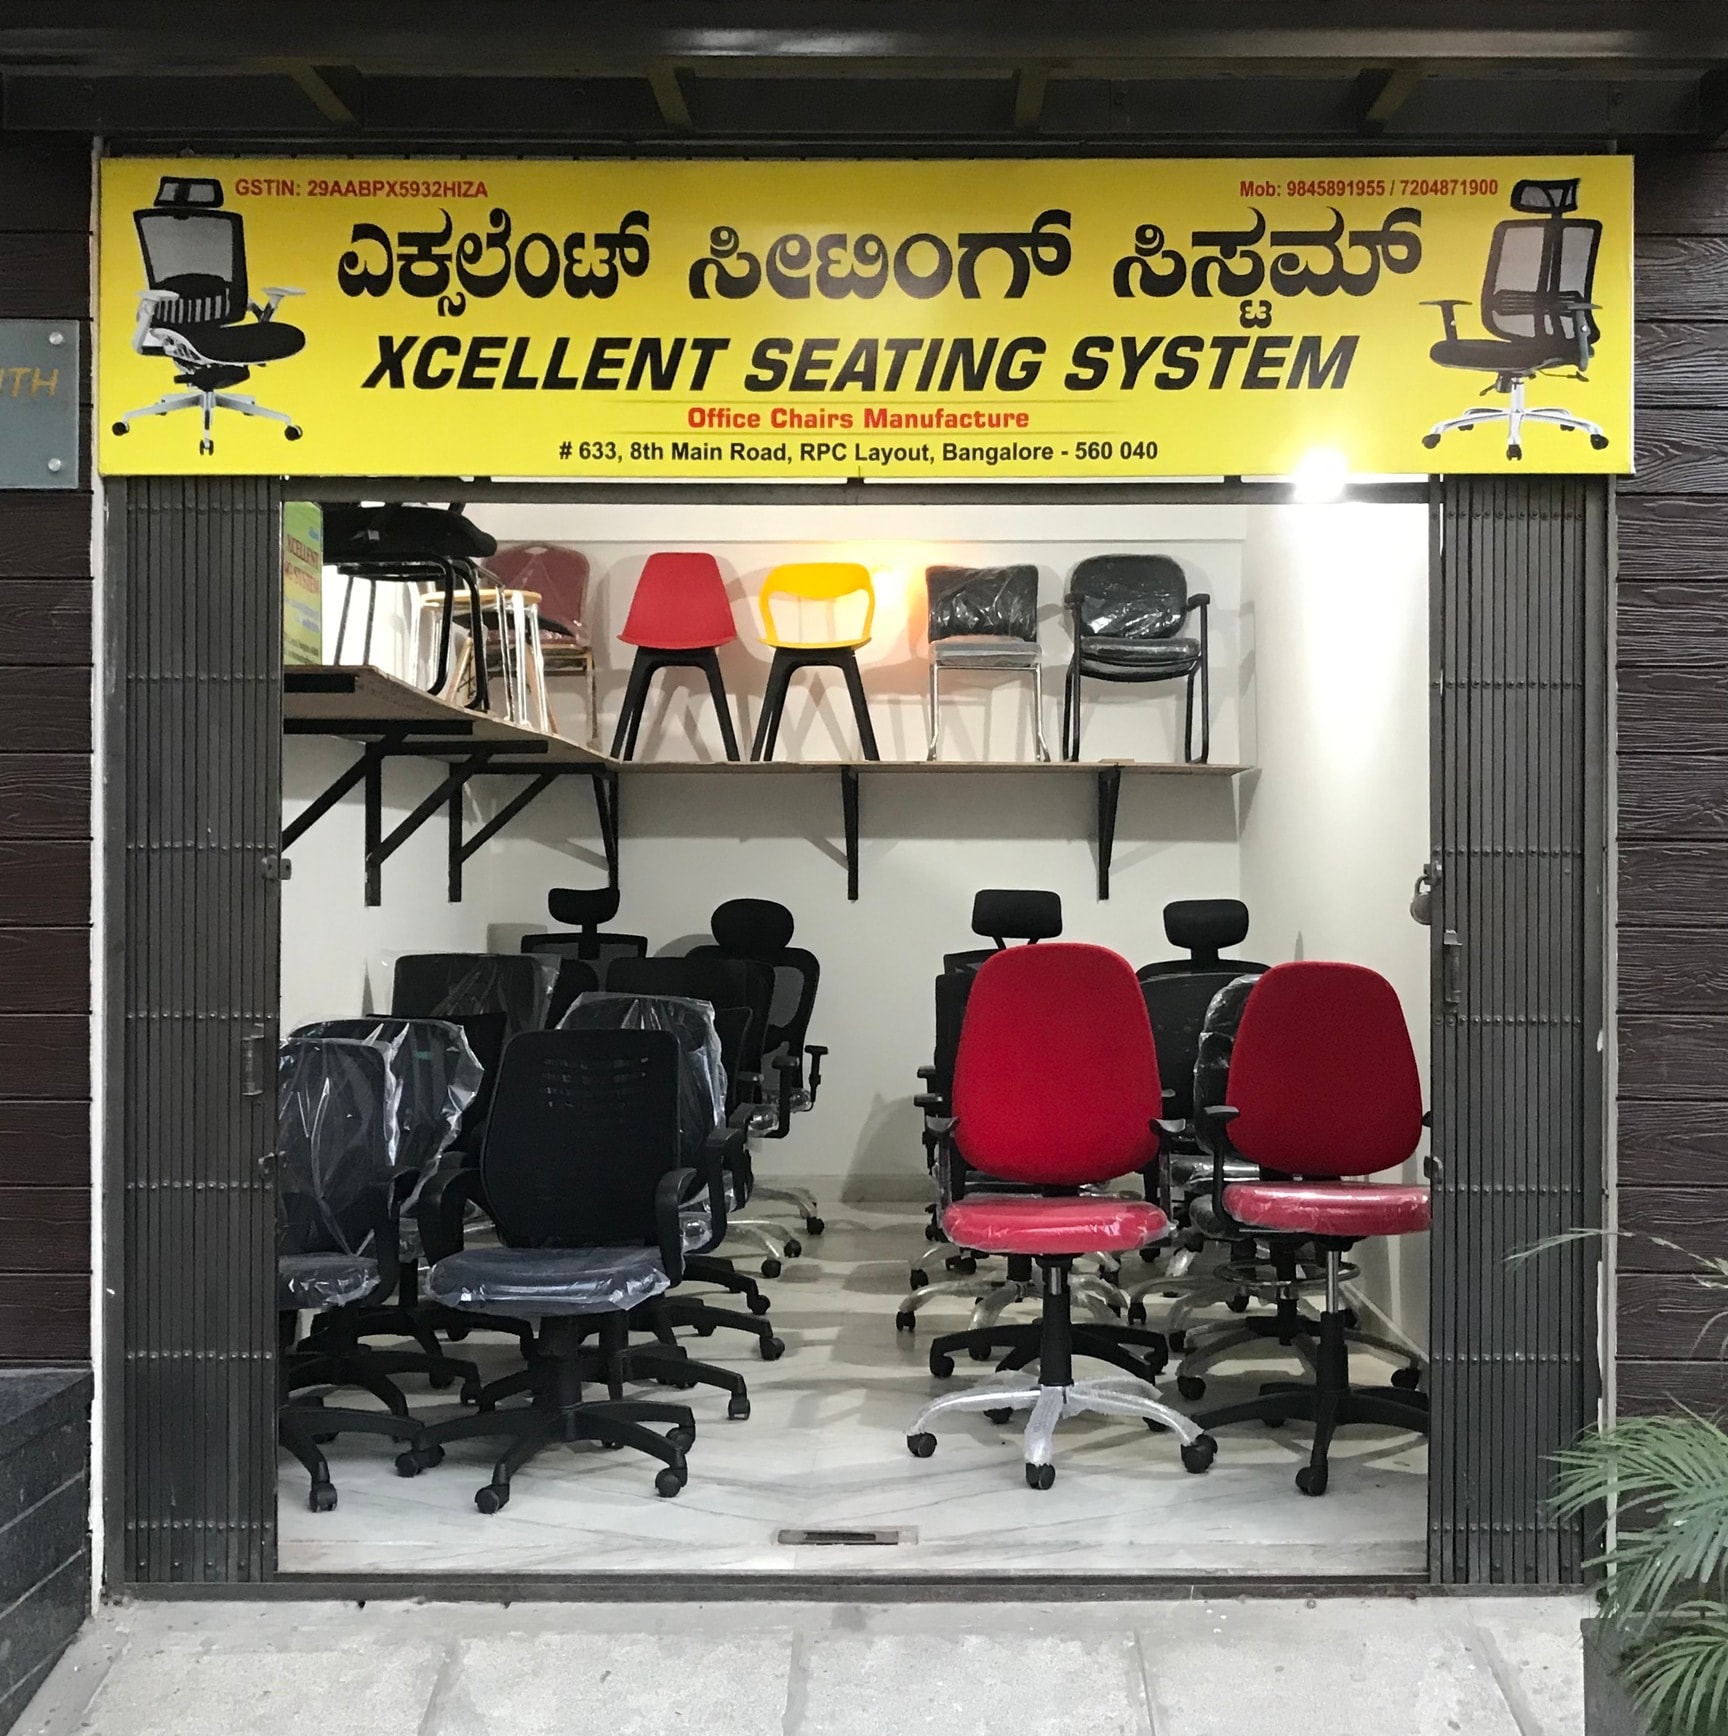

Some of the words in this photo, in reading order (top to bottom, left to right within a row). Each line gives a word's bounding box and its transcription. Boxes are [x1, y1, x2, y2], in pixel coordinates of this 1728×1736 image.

[235, 178, 301, 196] GSTIN:
[307, 180, 489, 198] 29AABPX5932HIZA
[1240, 180, 1281, 197] Mob:
[1287, 180, 1385, 197] 9845891955
[1400, 179, 1498, 196] 7204871900
[1113, 207, 1421, 328] ಸಿಸ್ಟಮ್
[362, 336, 730, 390] XCELLENT
[745, 336, 1046, 391] SEATING
[1065, 335, 1359, 391] SYSTEM
[688, 407, 760, 429] Office
[771, 408, 853, 429] Chairs
[864, 408, 1029, 429] Manufacture
[559, 441, 573, 460] #
[579, 441, 622, 463] 633,
[630, 441, 664, 461] 8th
[671, 442, 722, 461] Main
[730, 442, 792, 463] Road,
[800, 443, 847, 461] RPC
[855, 443, 934, 466] Layout,
[943, 443, 1053, 466] Bangalore
[1075, 441, 1113, 460] 560
[1120, 441, 1158, 460] 040
